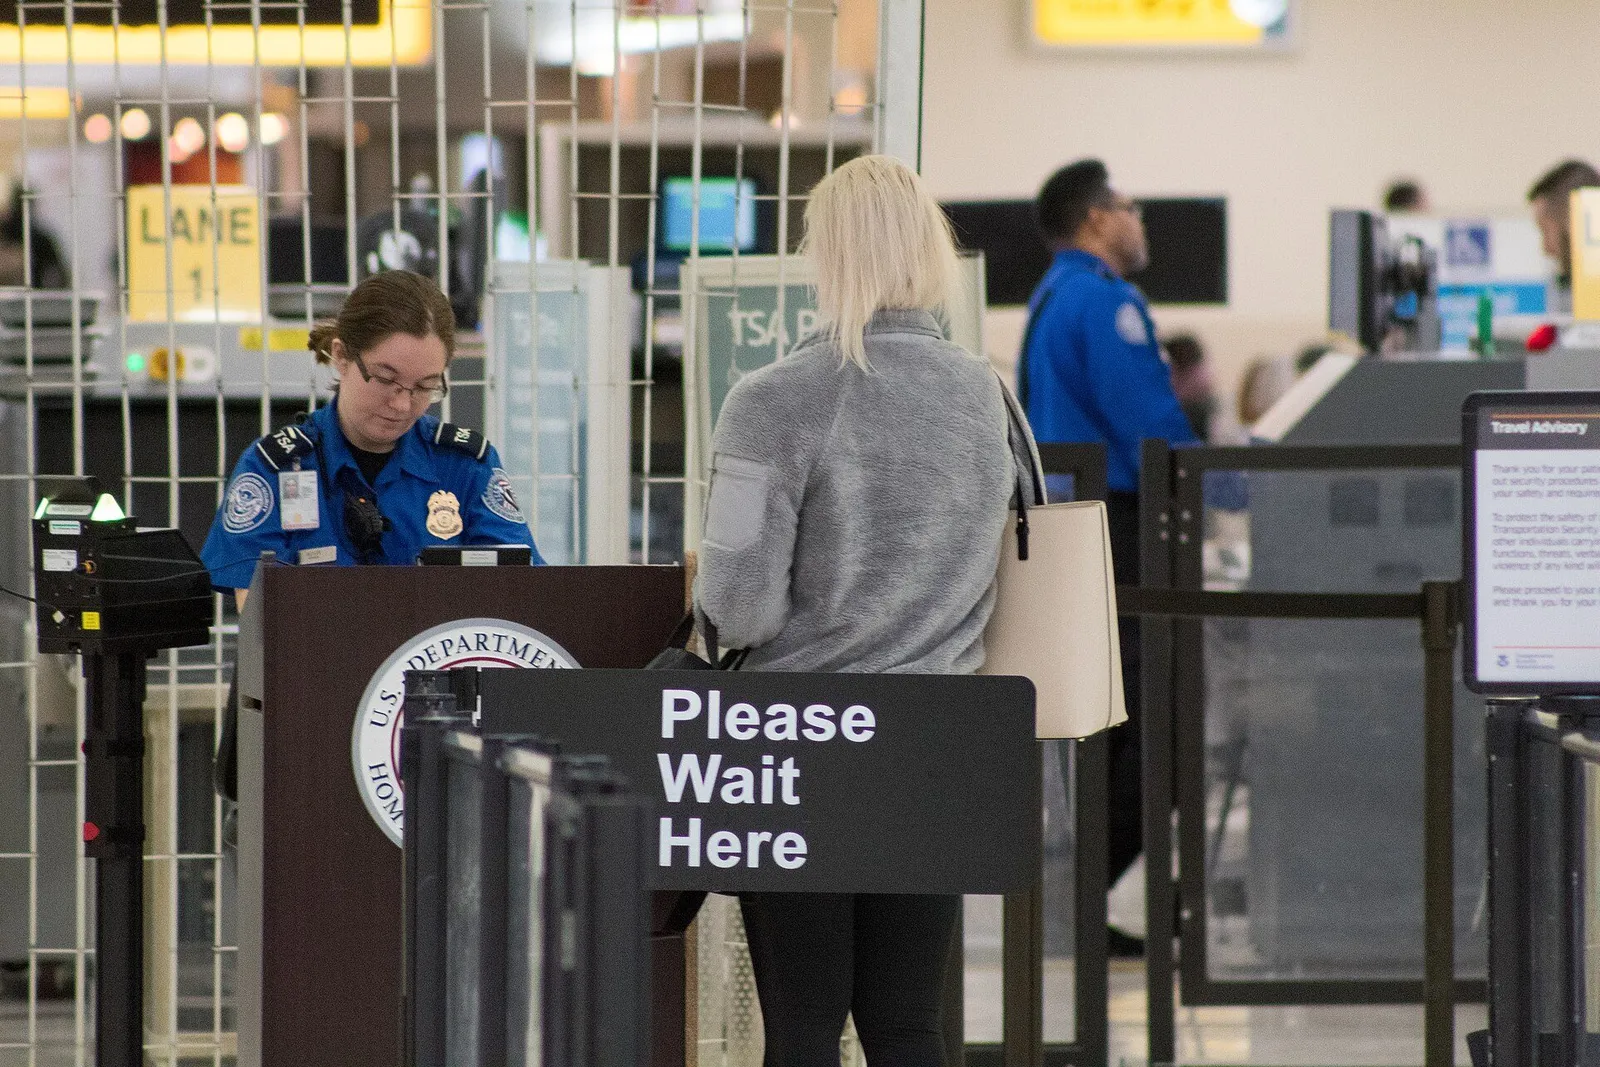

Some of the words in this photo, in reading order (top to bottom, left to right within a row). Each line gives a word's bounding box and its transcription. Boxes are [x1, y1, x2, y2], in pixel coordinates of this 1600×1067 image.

[140, 207, 253, 244] LANE
[190, 266, 202, 302] 1
[727, 309, 790, 347] TSA
[454, 427, 471, 443] TSA
[1491, 421, 1530, 433] Travel
[1532, 421, 1588, 435] Advisory
[273, 430, 296, 454] TSA
[1492, 465, 1519, 473] Thank
[1522, 465, 1539, 475] you
[1541, 465, 1555, 473] for
[1557, 465, 1579, 475] your
[1510, 478, 1544, 487] security
[1547, 478, 1599, 487] procedures
[1492, 490, 1512, 499] your
[1516, 490, 1543, 499] safety
[1547, 490, 1563, 498] and
[1492, 513, 1502, 521] To
[1505, 513, 1537, 522] protect
[1540, 513, 1555, 521] the
[1557, 513, 1584, 522] safety
[1587, 513, 1597, 521] of
[1492, 525, 1560, 534] Transportation
[1561, 525, 1597, 535] Security
[1492, 538, 1515, 546] other
[1519, 538, 1570, 546] individuals
[1492, 562, 1530, 570] violence
[1532, 562, 1542, 570] of
[1544, 562, 1561, 571] any
[1563, 562, 1584, 570] kind
[1492, 586, 1521, 594] Please
[1524, 586, 1560, 595] proceed
[1562, 586, 1573, 594] to
[1574, 586, 1596, 595] your
[1539, 599, 1557, 607] you
[1574, 599, 1596, 608] your
[370, 689, 402, 728] U.S.
[661, 689, 876, 742] Please
[657, 753, 800, 805] Wait
[659, 817, 807, 870] Here
